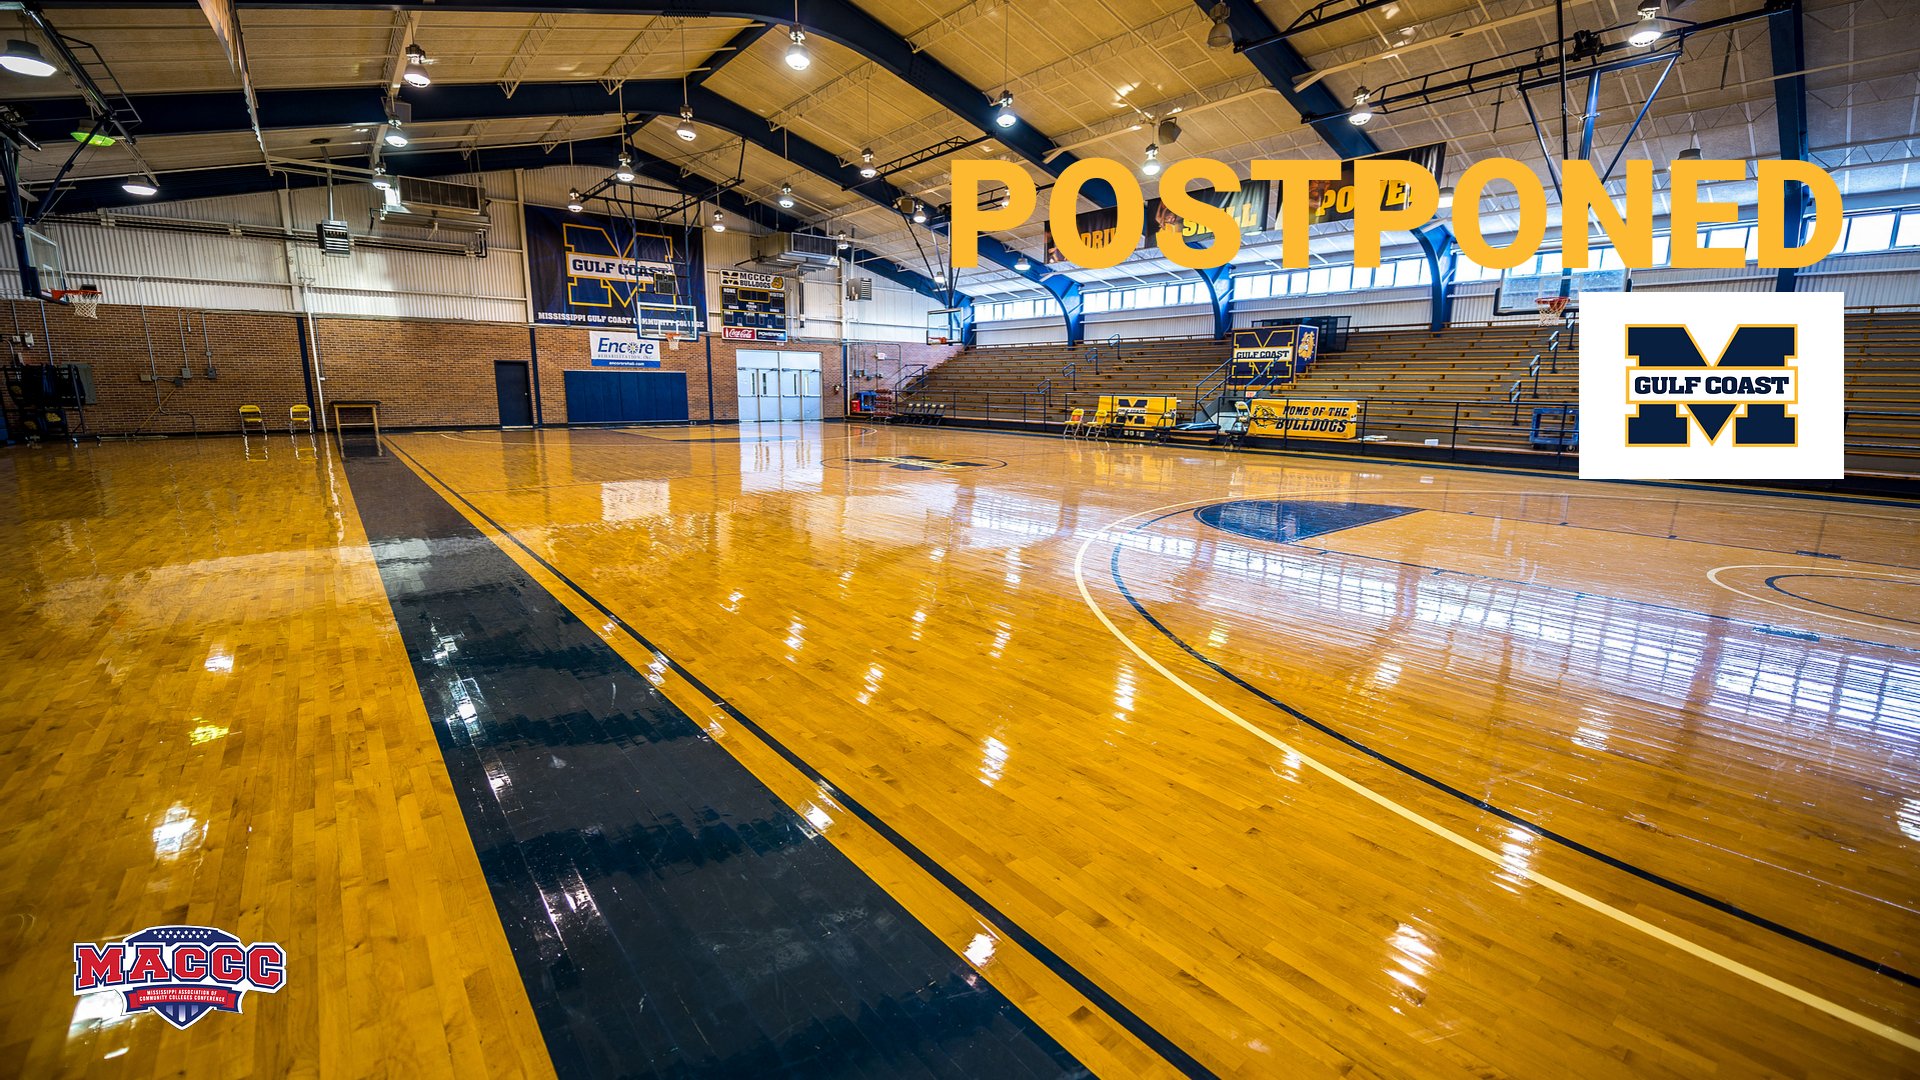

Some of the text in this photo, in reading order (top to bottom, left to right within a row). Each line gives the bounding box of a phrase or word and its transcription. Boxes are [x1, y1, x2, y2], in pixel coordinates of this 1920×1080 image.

[572, 259, 616, 275] GULF
[740, 272, 771, 282] MGCCC
[740, 280, 771, 288] BULLDOGS
[538, 312, 586, 322] MISSISSIPPI
[587, 315, 607, 323] GULF
[608, 316, 632, 325] COAST
[1236, 350, 1290, 359] GULF COAST
[1283, 405, 1349, 417] HOME OF THE
[1275, 418, 1348, 433] BULLDOGS
